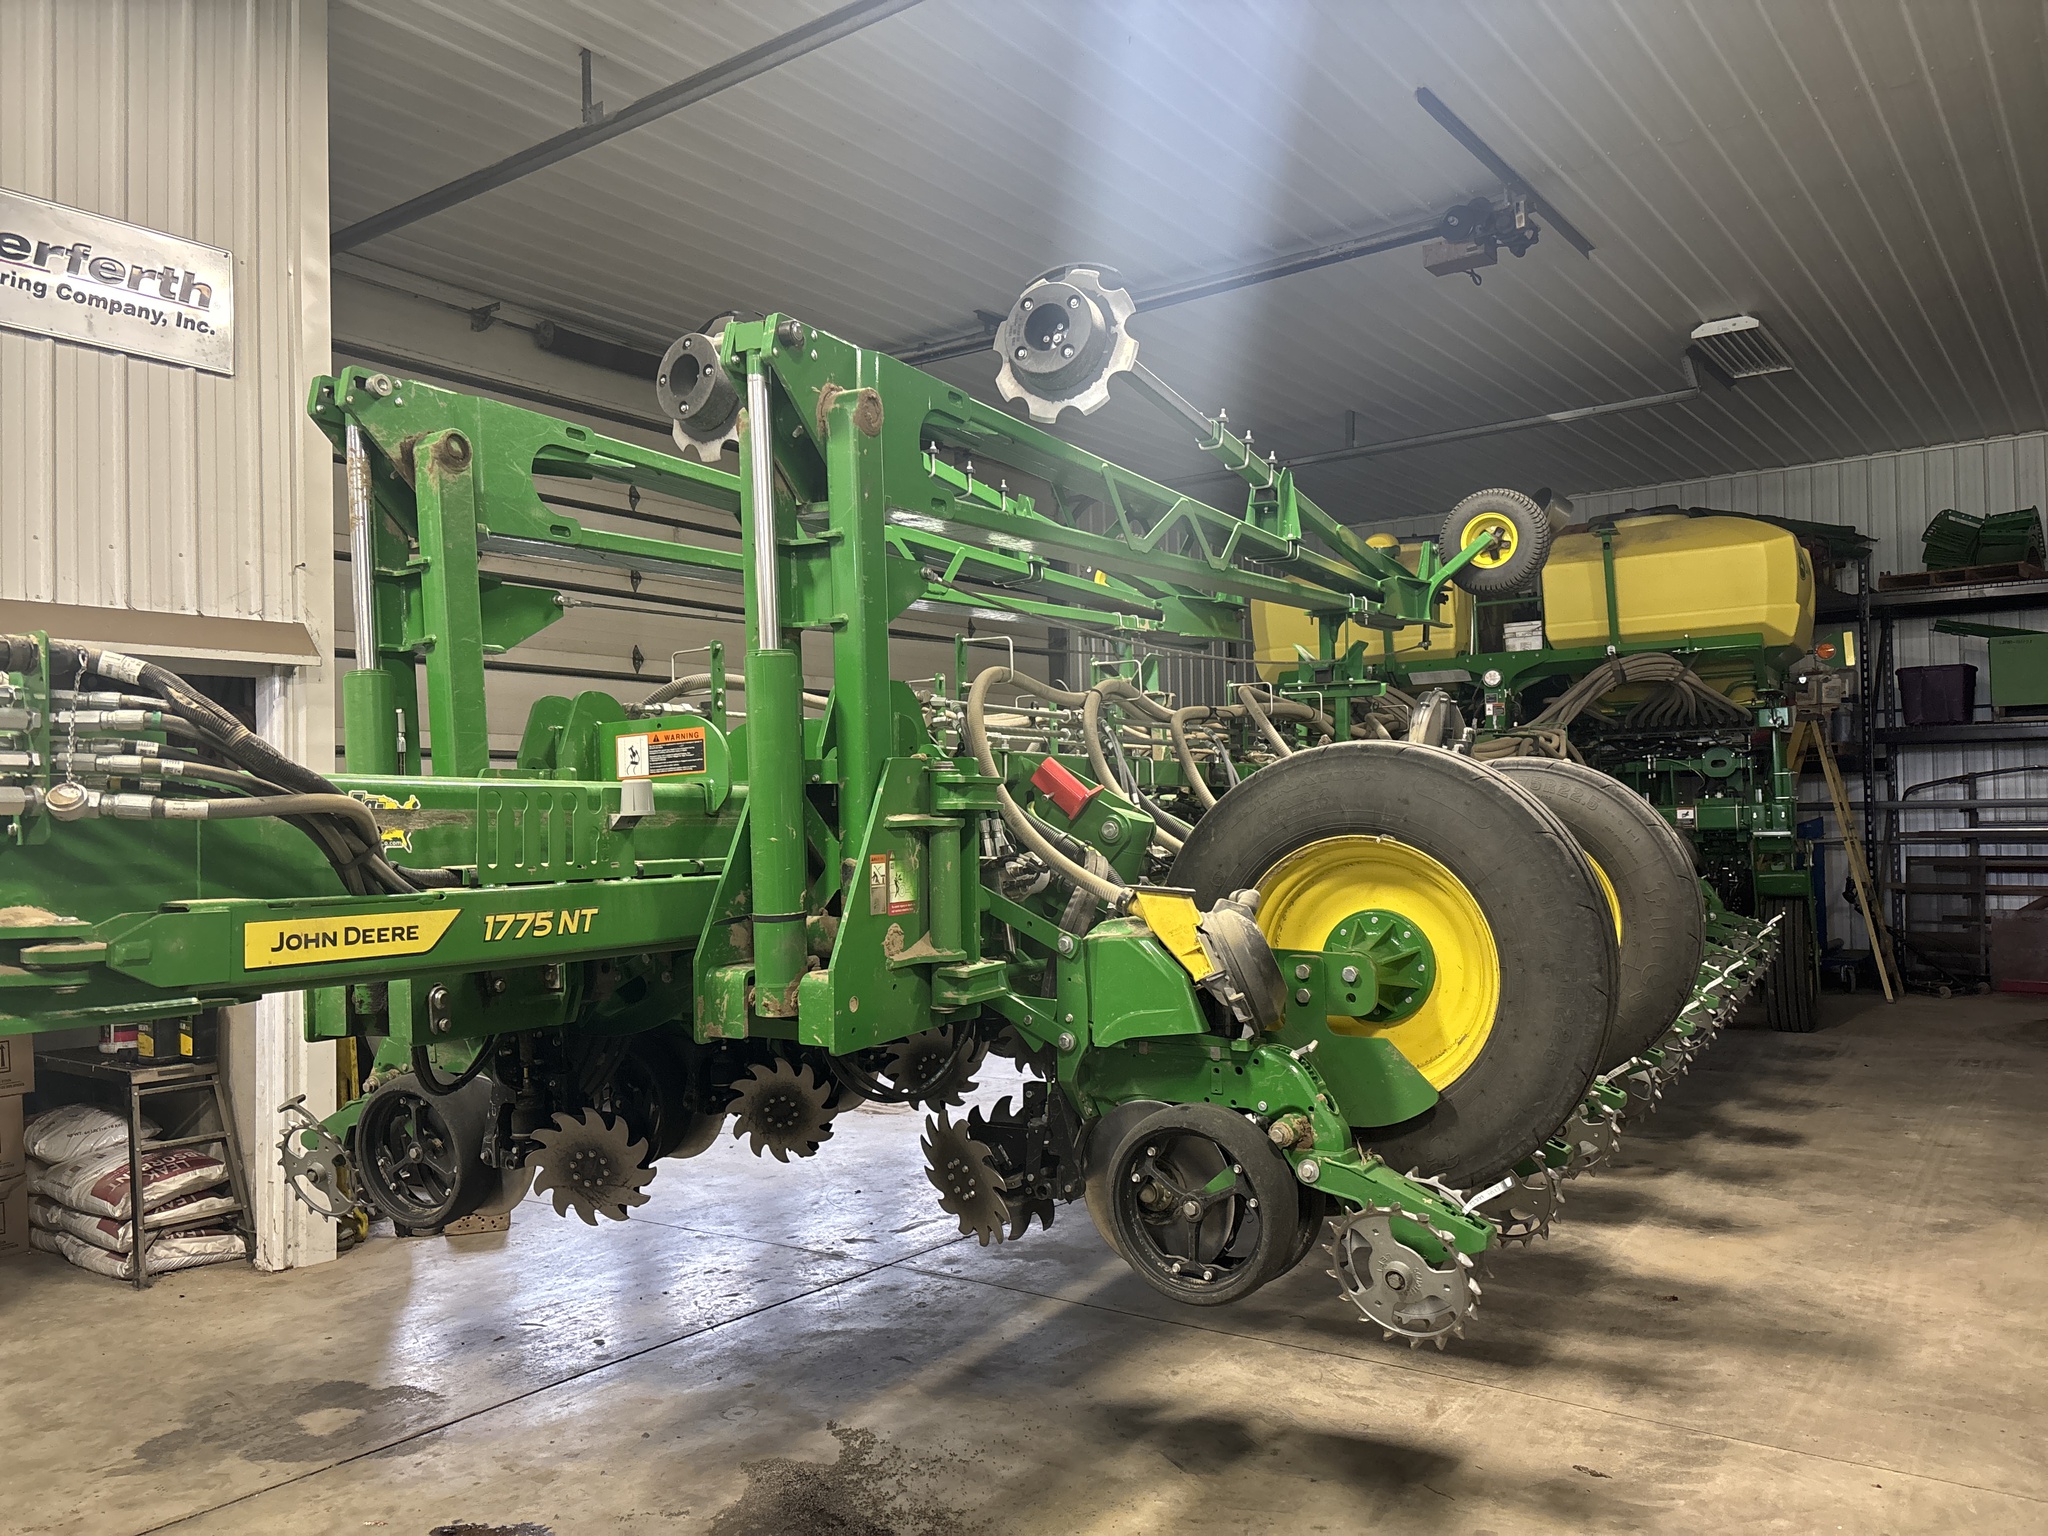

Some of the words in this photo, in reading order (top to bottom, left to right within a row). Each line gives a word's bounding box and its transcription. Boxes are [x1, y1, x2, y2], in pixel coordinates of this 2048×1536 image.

[56, 282, 168, 327] Company,
[175, 311, 216, 335] Inc.
[664, 731, 700, 742] WARNING
[270, 928, 338, 953] JOHN
[344, 924, 420, 946] DEERE
[149, 1160, 191, 1180] LEAK
